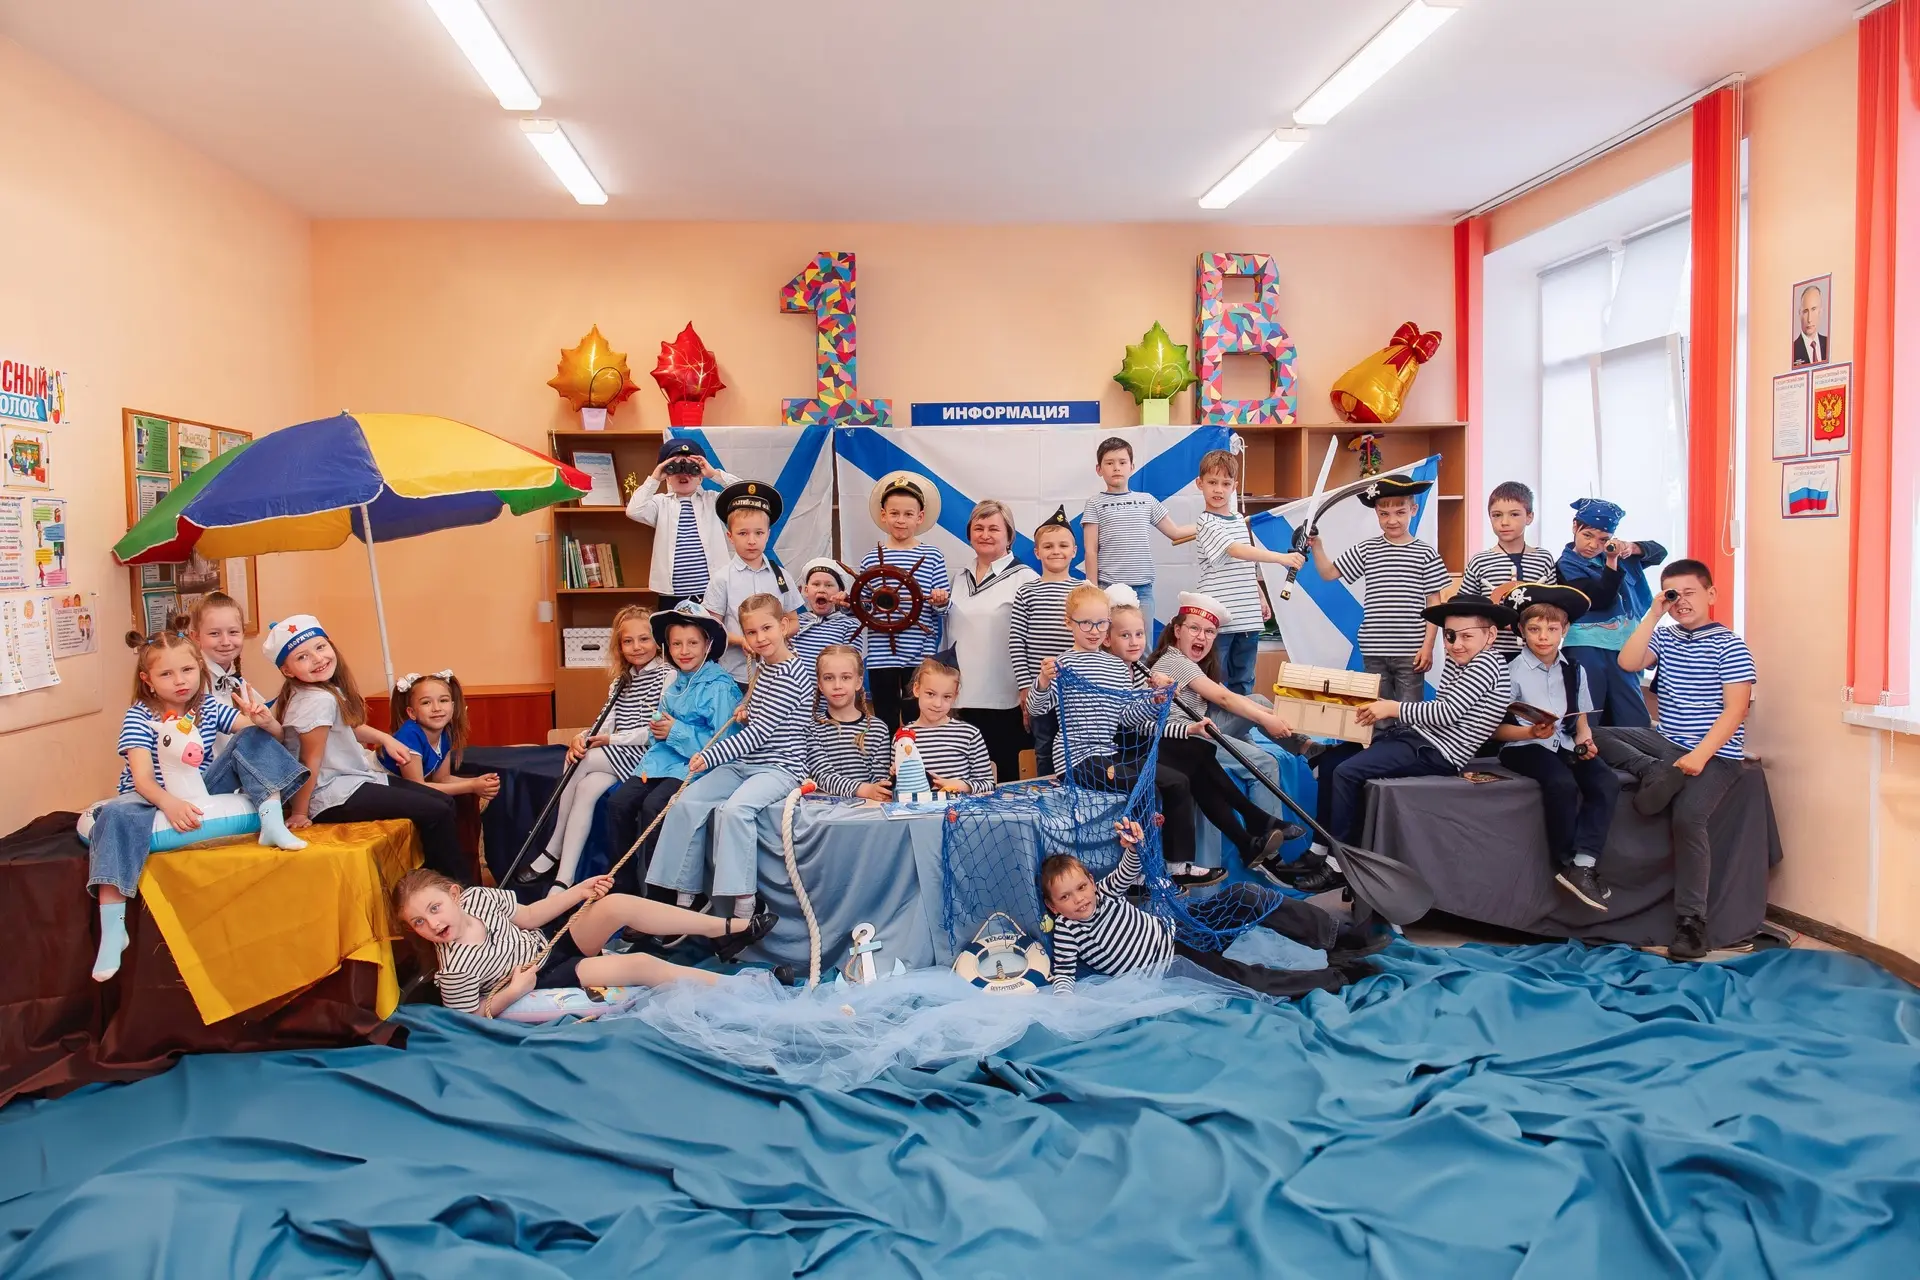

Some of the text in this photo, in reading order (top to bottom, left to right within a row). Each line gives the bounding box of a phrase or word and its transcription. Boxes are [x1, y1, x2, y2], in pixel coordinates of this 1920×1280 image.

[780, 252, 892, 427] 1
[0, 360, 48, 399] СНЫЙ
[942, 405, 1069, 421] ИНФОРМАЦИЯ
[287, 630, 317, 650] МОРЯЧОК
